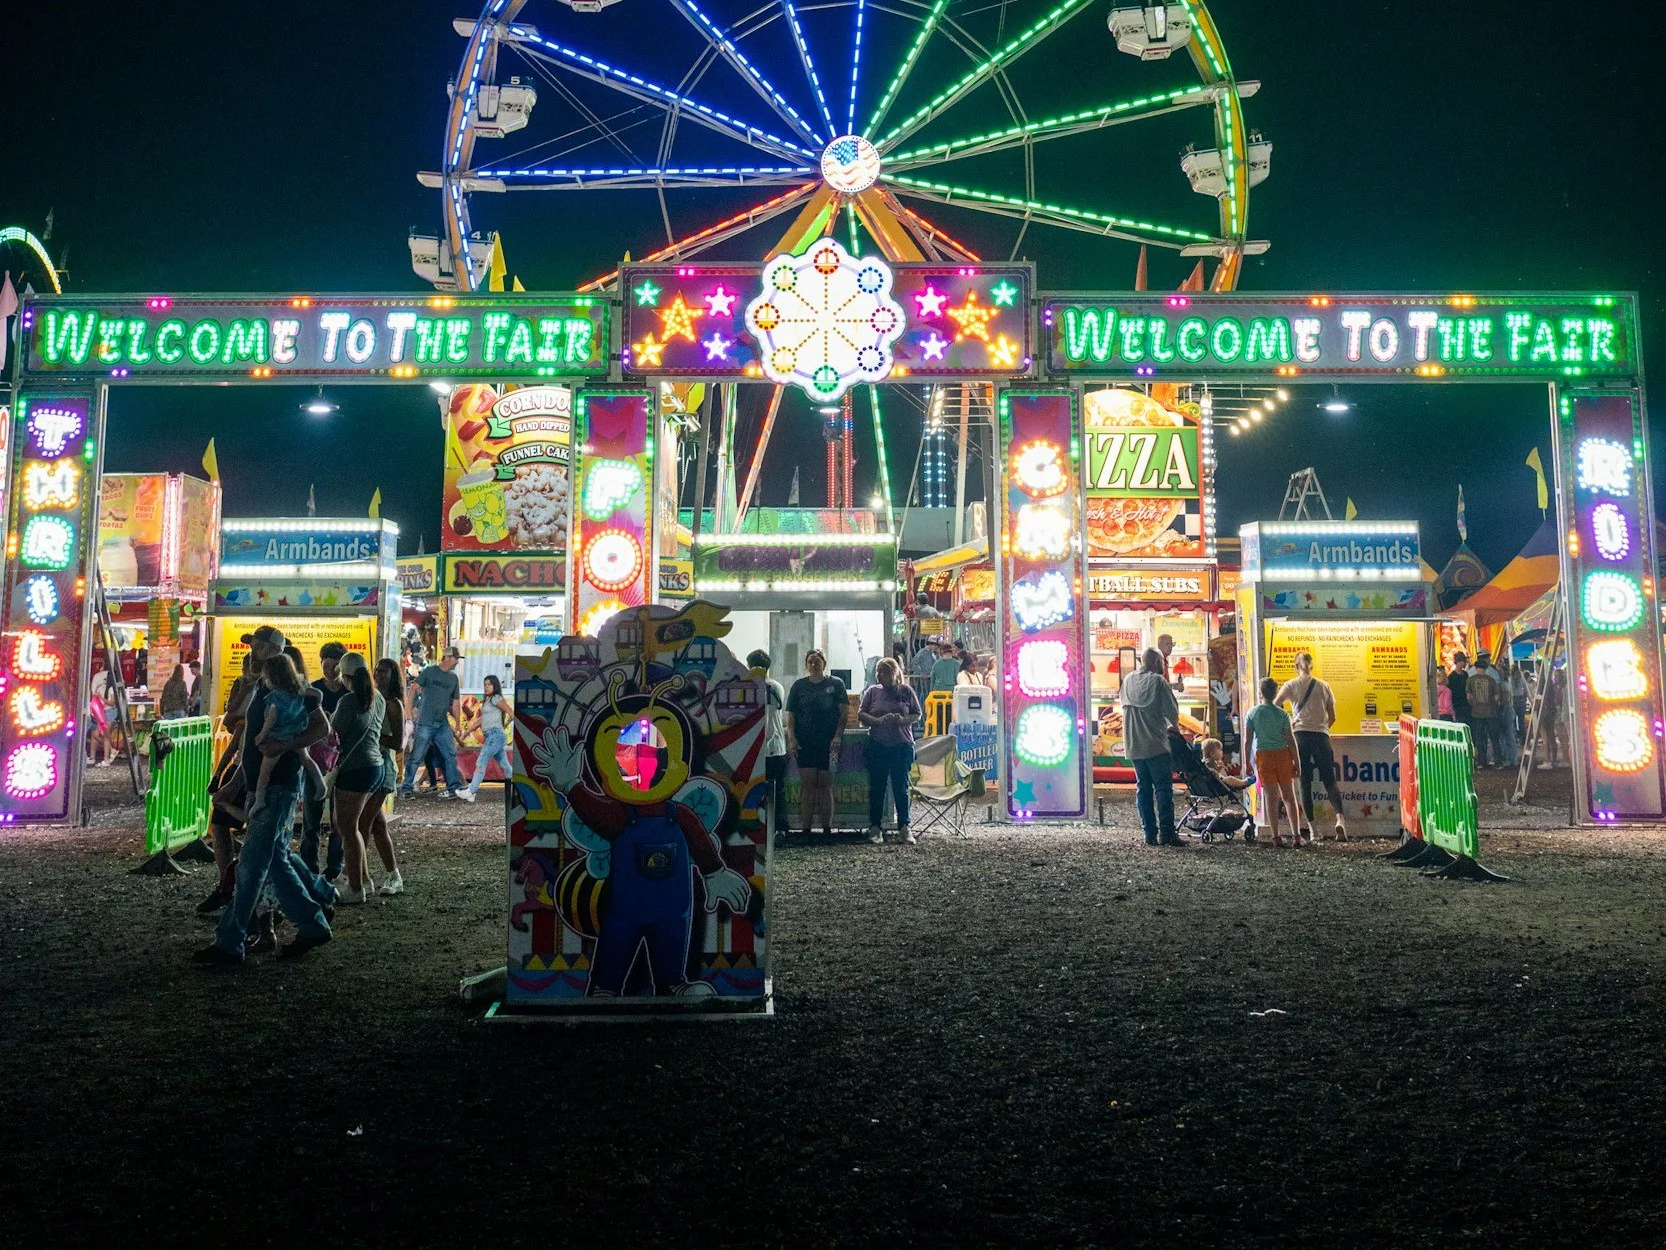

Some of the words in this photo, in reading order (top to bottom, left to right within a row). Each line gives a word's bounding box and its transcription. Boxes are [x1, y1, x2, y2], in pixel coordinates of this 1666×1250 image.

[510, 76, 520, 85] 5
[1249, 134, 1262, 142] 11
[471, 231, 481, 240] 4
[544, 395, 570, 412] DO
[516, 422, 538, 433] HAND
[541, 421, 570, 432] DIPPED
[502, 445, 543, 464] FUNNEL
[1085, 433, 1196, 490] IZZA
[1087, 507, 1108, 520] esh
[255, 537, 360, 560] Armbands
[1309, 540, 1412, 563] Armbands
[659, 571, 690, 591] NKS
[763, 570, 825, 581] CHANGE
[1088, 576, 1147, 593] TBALL
[1150, 576, 1199, 593] SUBS
[1011, 439, 1073, 766] GAMES
[1577, 437, 1653, 772] RIDES
[961, 743, 998, 762] BOTTLED
[1368, 792, 1378, 800] to
[1381, 791, 1398, 800] Fun
